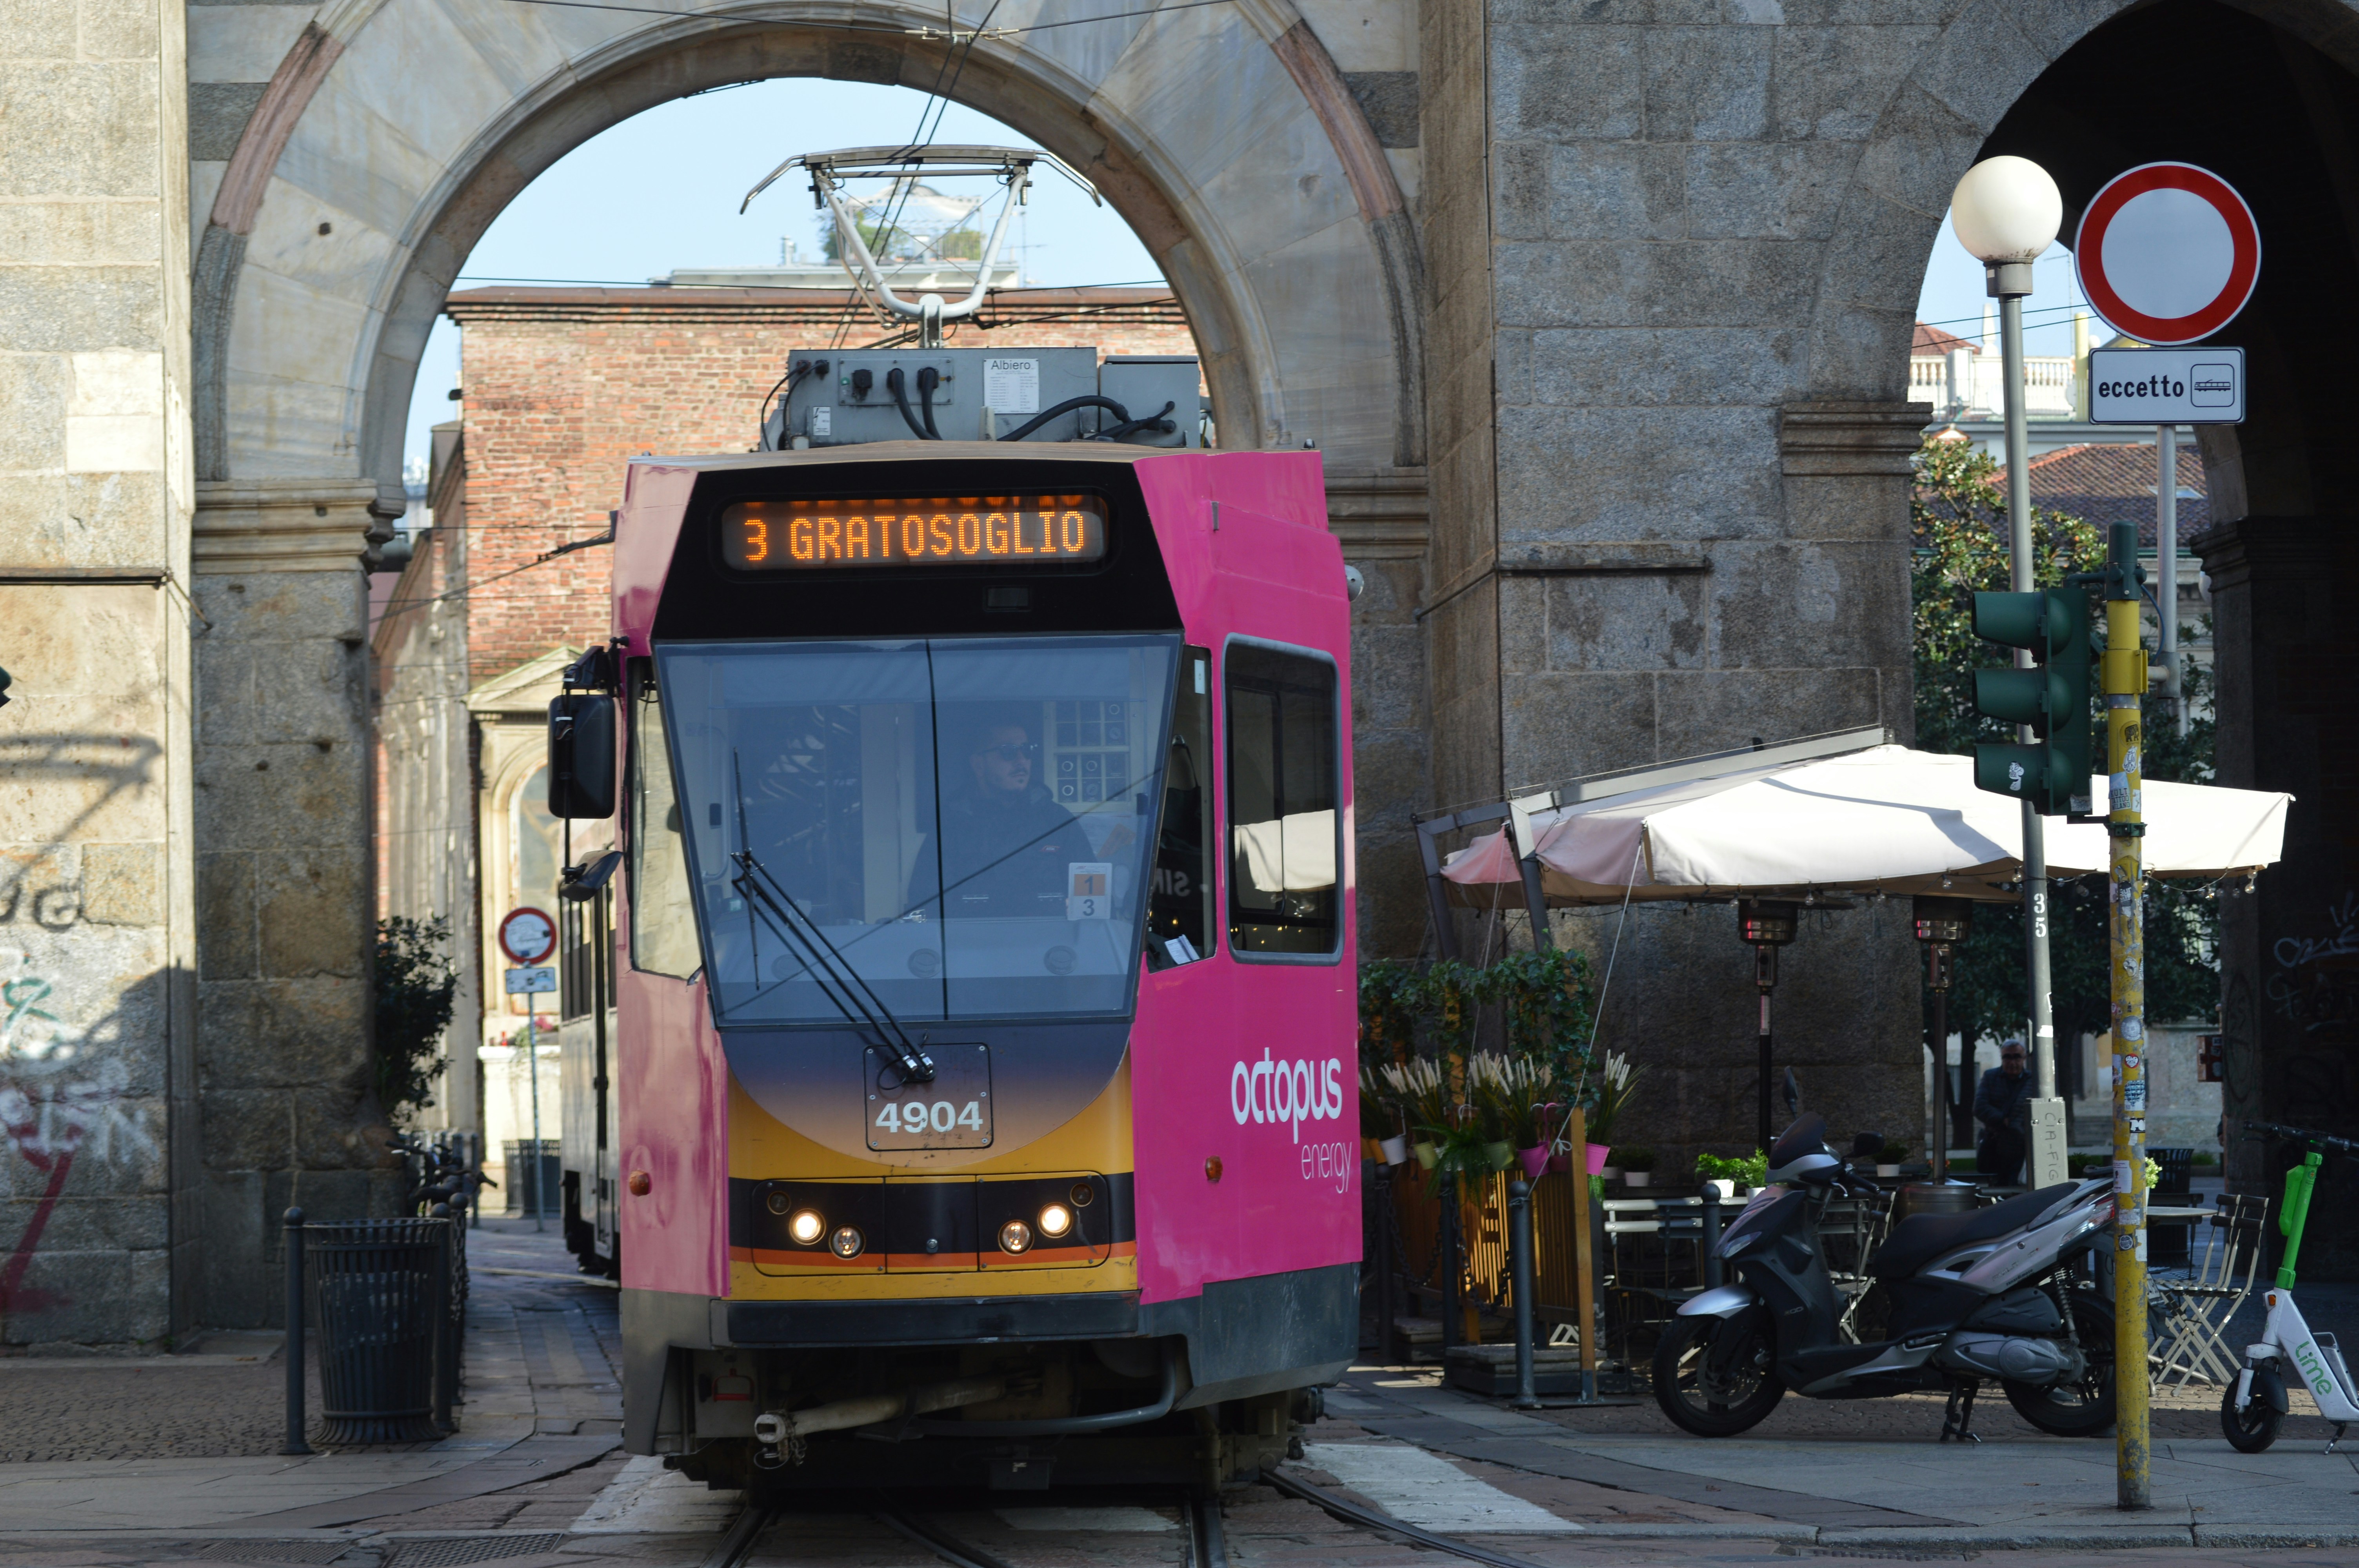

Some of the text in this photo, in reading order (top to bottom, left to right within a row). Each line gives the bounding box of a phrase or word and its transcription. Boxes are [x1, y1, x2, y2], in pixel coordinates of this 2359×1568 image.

[991, 360, 1030, 370] Albiero
[2099, 374, 2185, 398] eccetto
[745, 511, 1084, 561] 3 GRATOSOGLIO
[1085, 876, 1093, 894] 1
[1083, 899, 1095, 916] 3
[1231, 1047, 1342, 1144] octopus
[876, 1101, 983, 1133] 4904
[1301, 1142, 1352, 1194] energy
